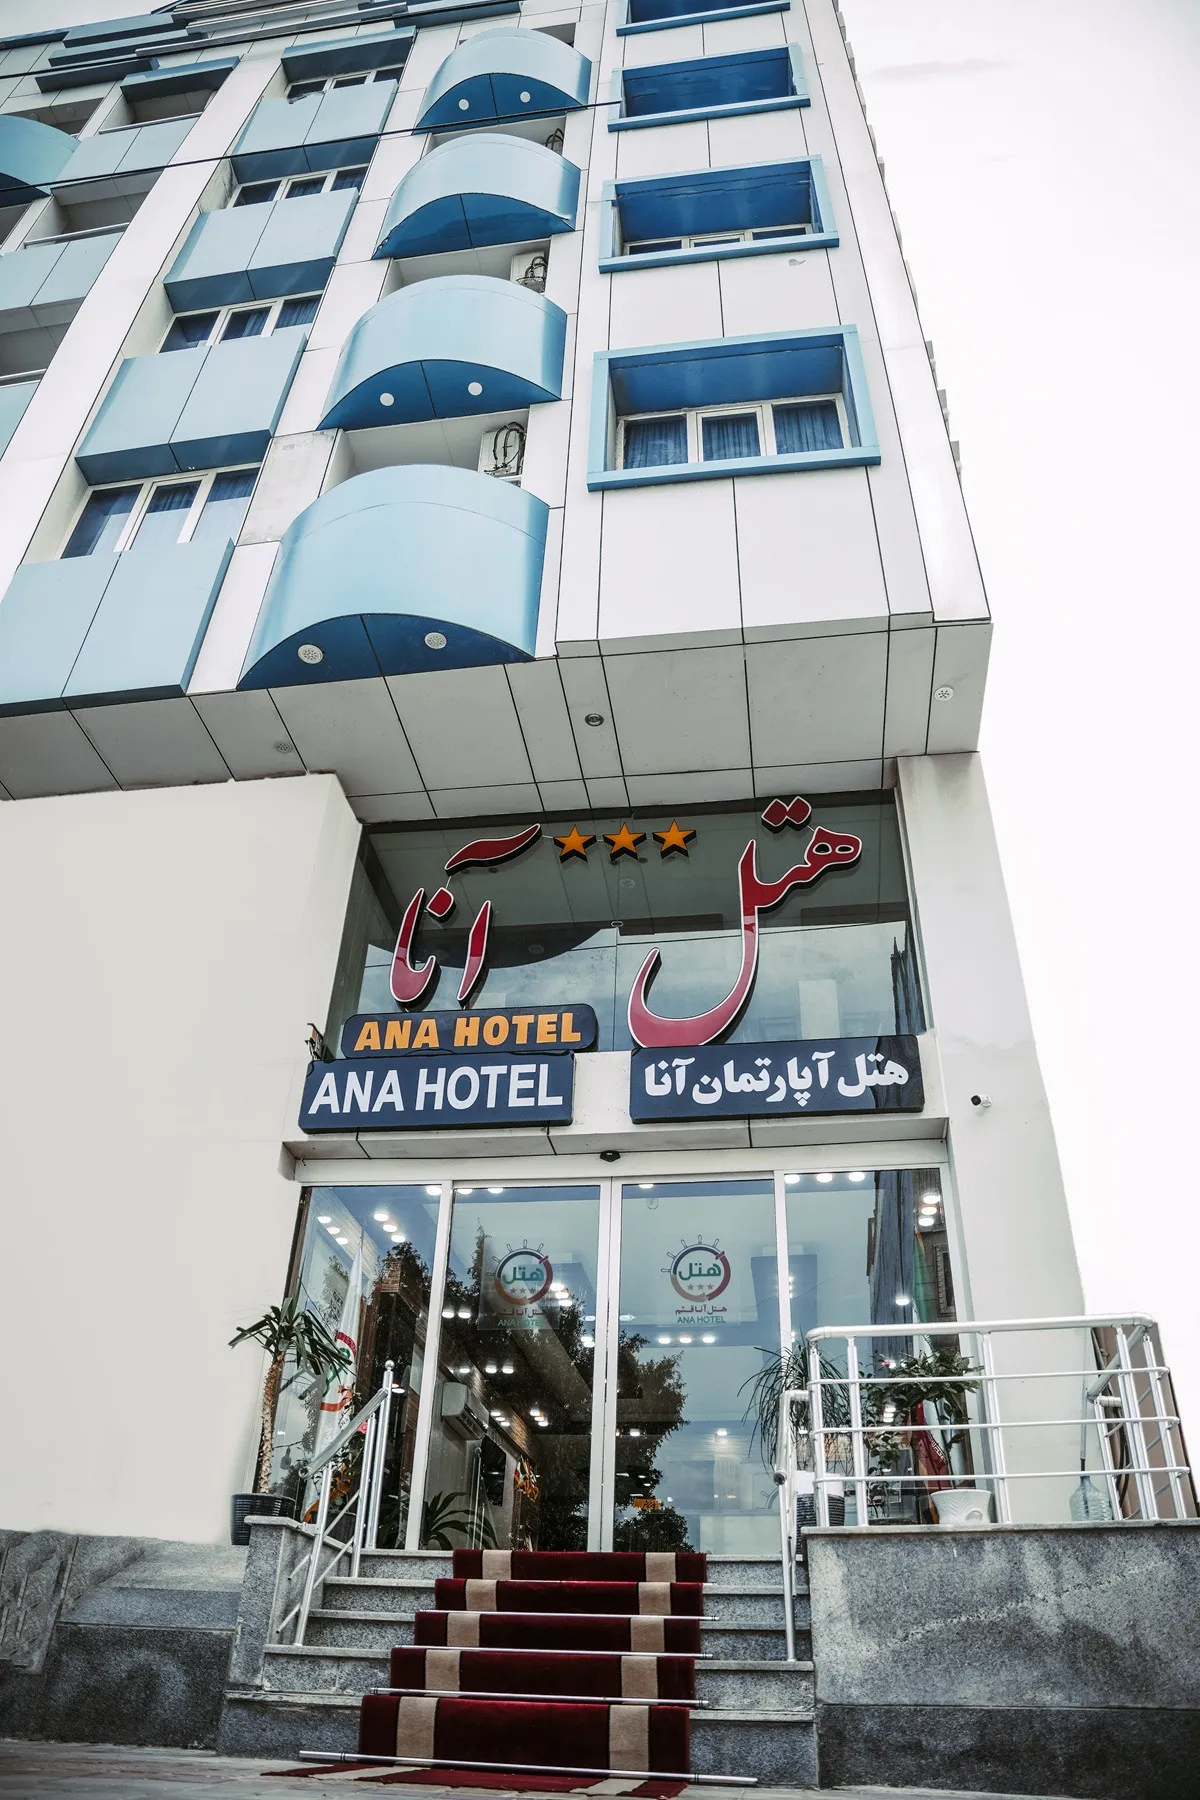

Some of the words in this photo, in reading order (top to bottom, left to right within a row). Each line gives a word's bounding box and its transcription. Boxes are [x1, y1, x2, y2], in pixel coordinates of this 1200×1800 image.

[390, 823, 542, 1003] آنا
[627, 796, 863, 1047] هتل
[354, 1018, 440, 1051] ANA
[453, 1012, 582, 1047] HOTEL
[308, 1070, 405, 1115] ANA
[415, 1063, 563, 1111] HOTEL
[644, 1057, 696, 1097] آنا
[692, 1051, 836, 1107] آپارتمان
[837, 1052, 910, 1097] هتل
[502, 1266, 544, 1284] هتل
[679, 1262, 721, 1281] هتل
[677, 1316, 696, 1324] ANA
[697, 1315, 726, 1324] HOTEL
[695, 1303, 707, 1313] آنا
[707, 1305, 728, 1315] هتل
